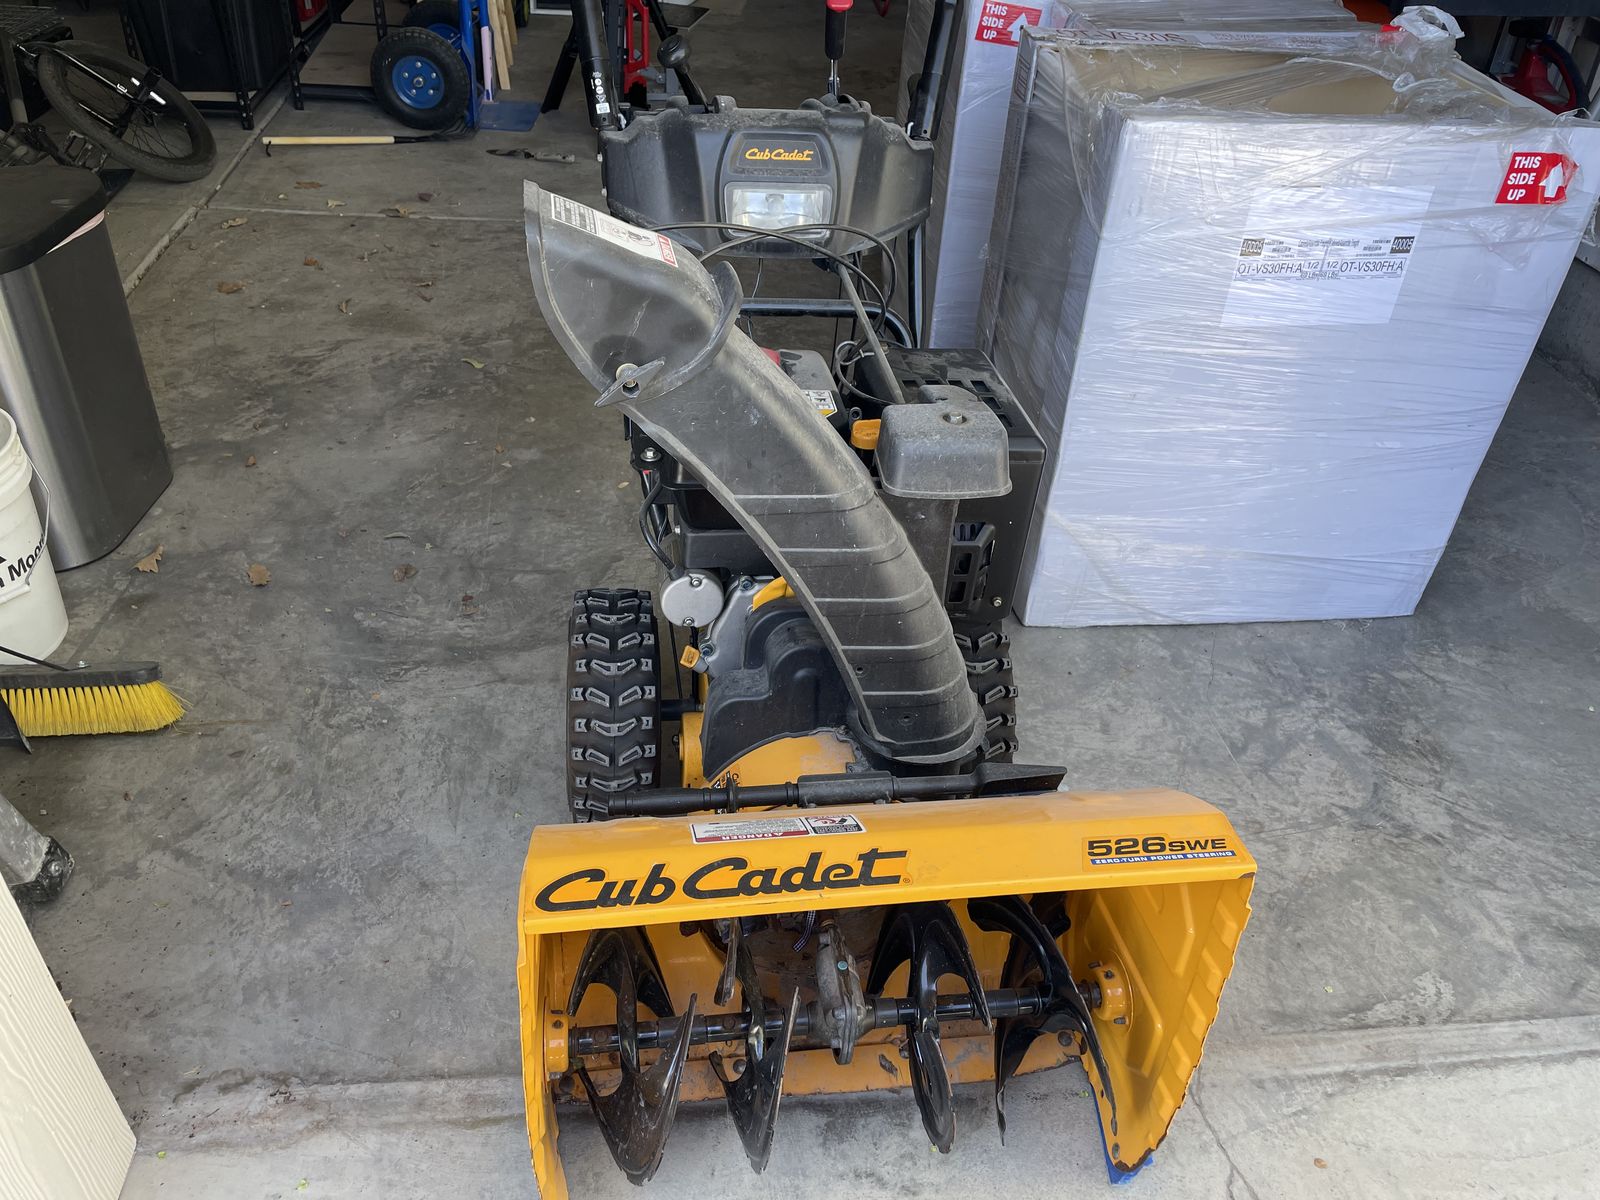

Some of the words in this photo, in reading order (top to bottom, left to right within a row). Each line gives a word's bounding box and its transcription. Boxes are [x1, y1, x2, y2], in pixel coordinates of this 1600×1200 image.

[985, 3, 1008, 16] THIS
[981, 15, 1005, 29] SIDE
[982, 29, 998, 40] UP
[745, 147, 771, 160] Cub
[771, 148, 814, 161] Cadet
[1514, 156, 1541, 169] THIS
[1507, 172, 1536, 185] SIDE
[1507, 189, 1526, 201] UP
[1326, 260, 1339, 269] 1/2
[1186, 851, 1233, 859] STEERING
[535, 863, 676, 912] Cub
[682, 848, 908, 900] Cadet
